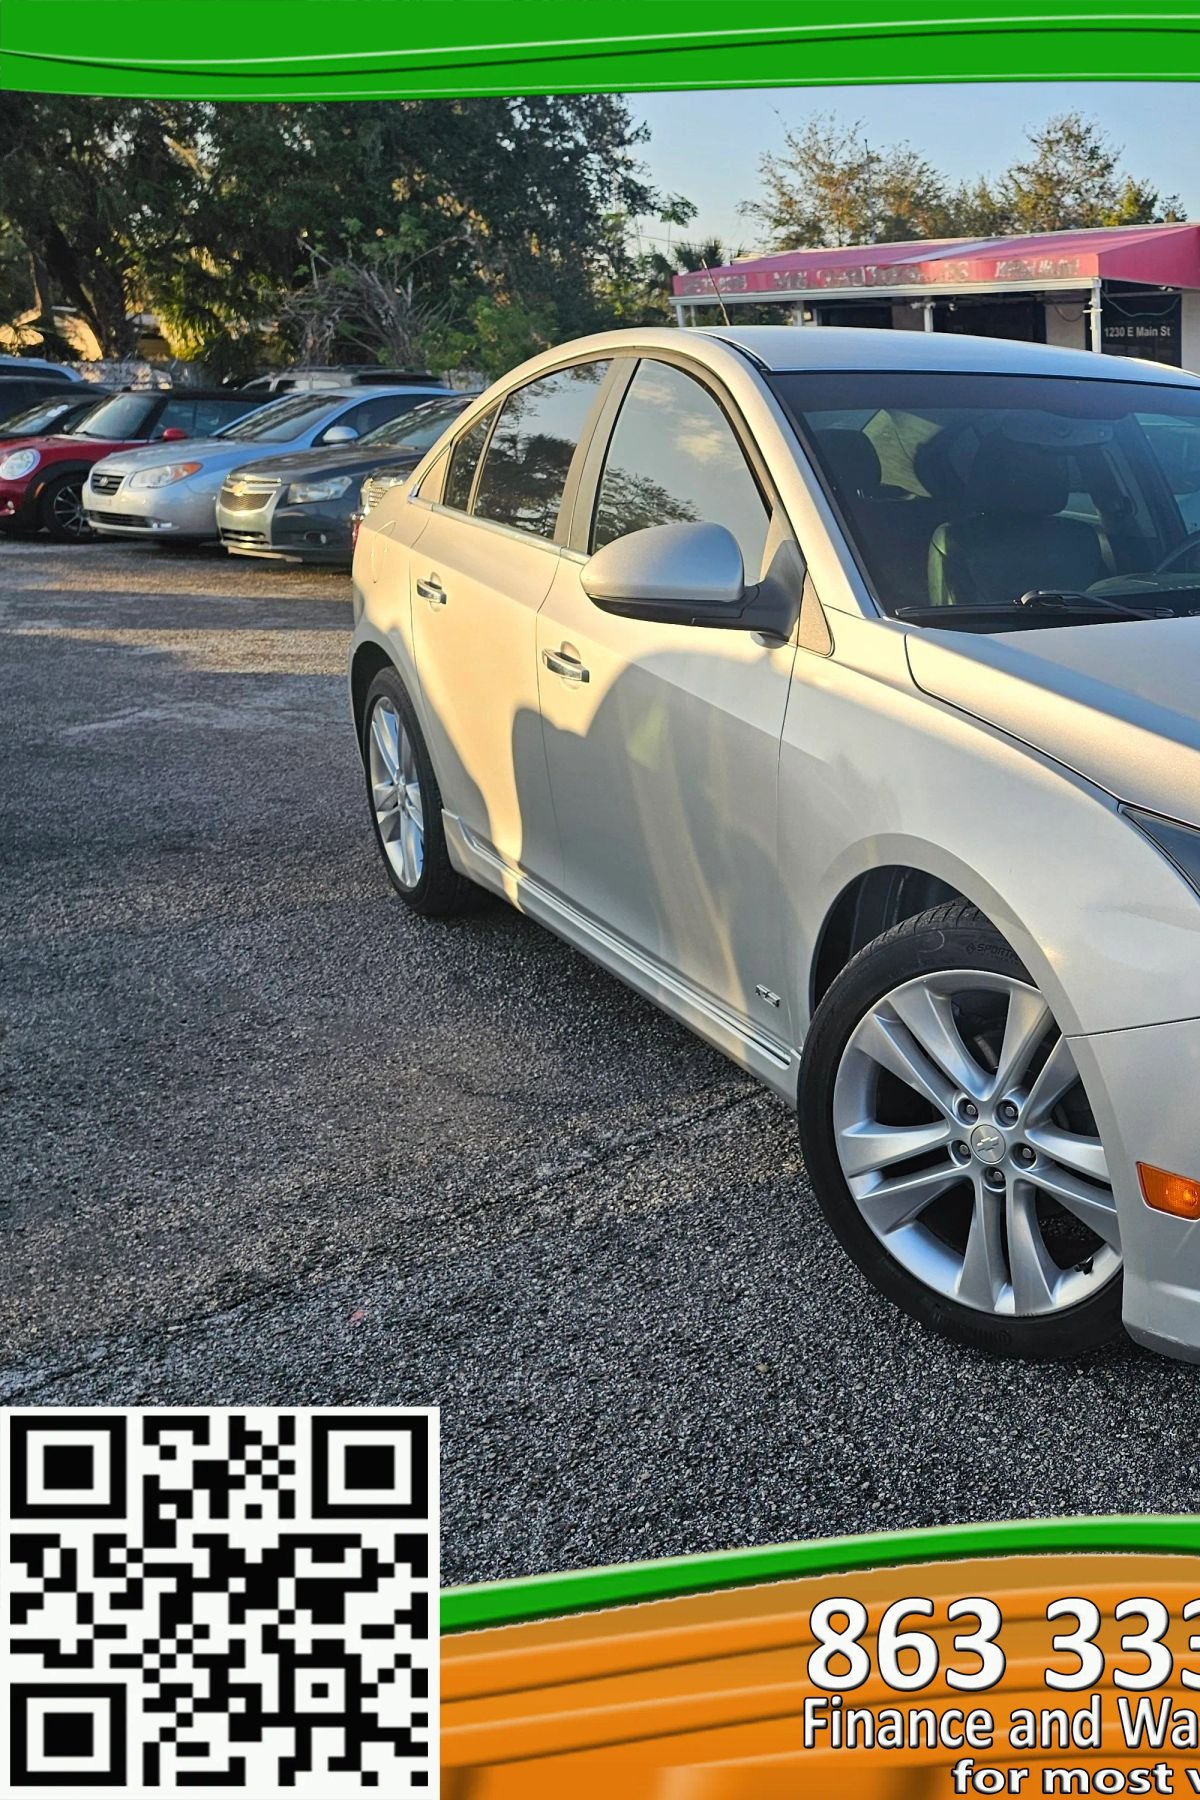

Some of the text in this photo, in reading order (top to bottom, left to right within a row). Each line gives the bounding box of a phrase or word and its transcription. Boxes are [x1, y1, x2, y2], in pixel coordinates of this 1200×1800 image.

[1104, 325, 1171, 337] 1230 E Main St
